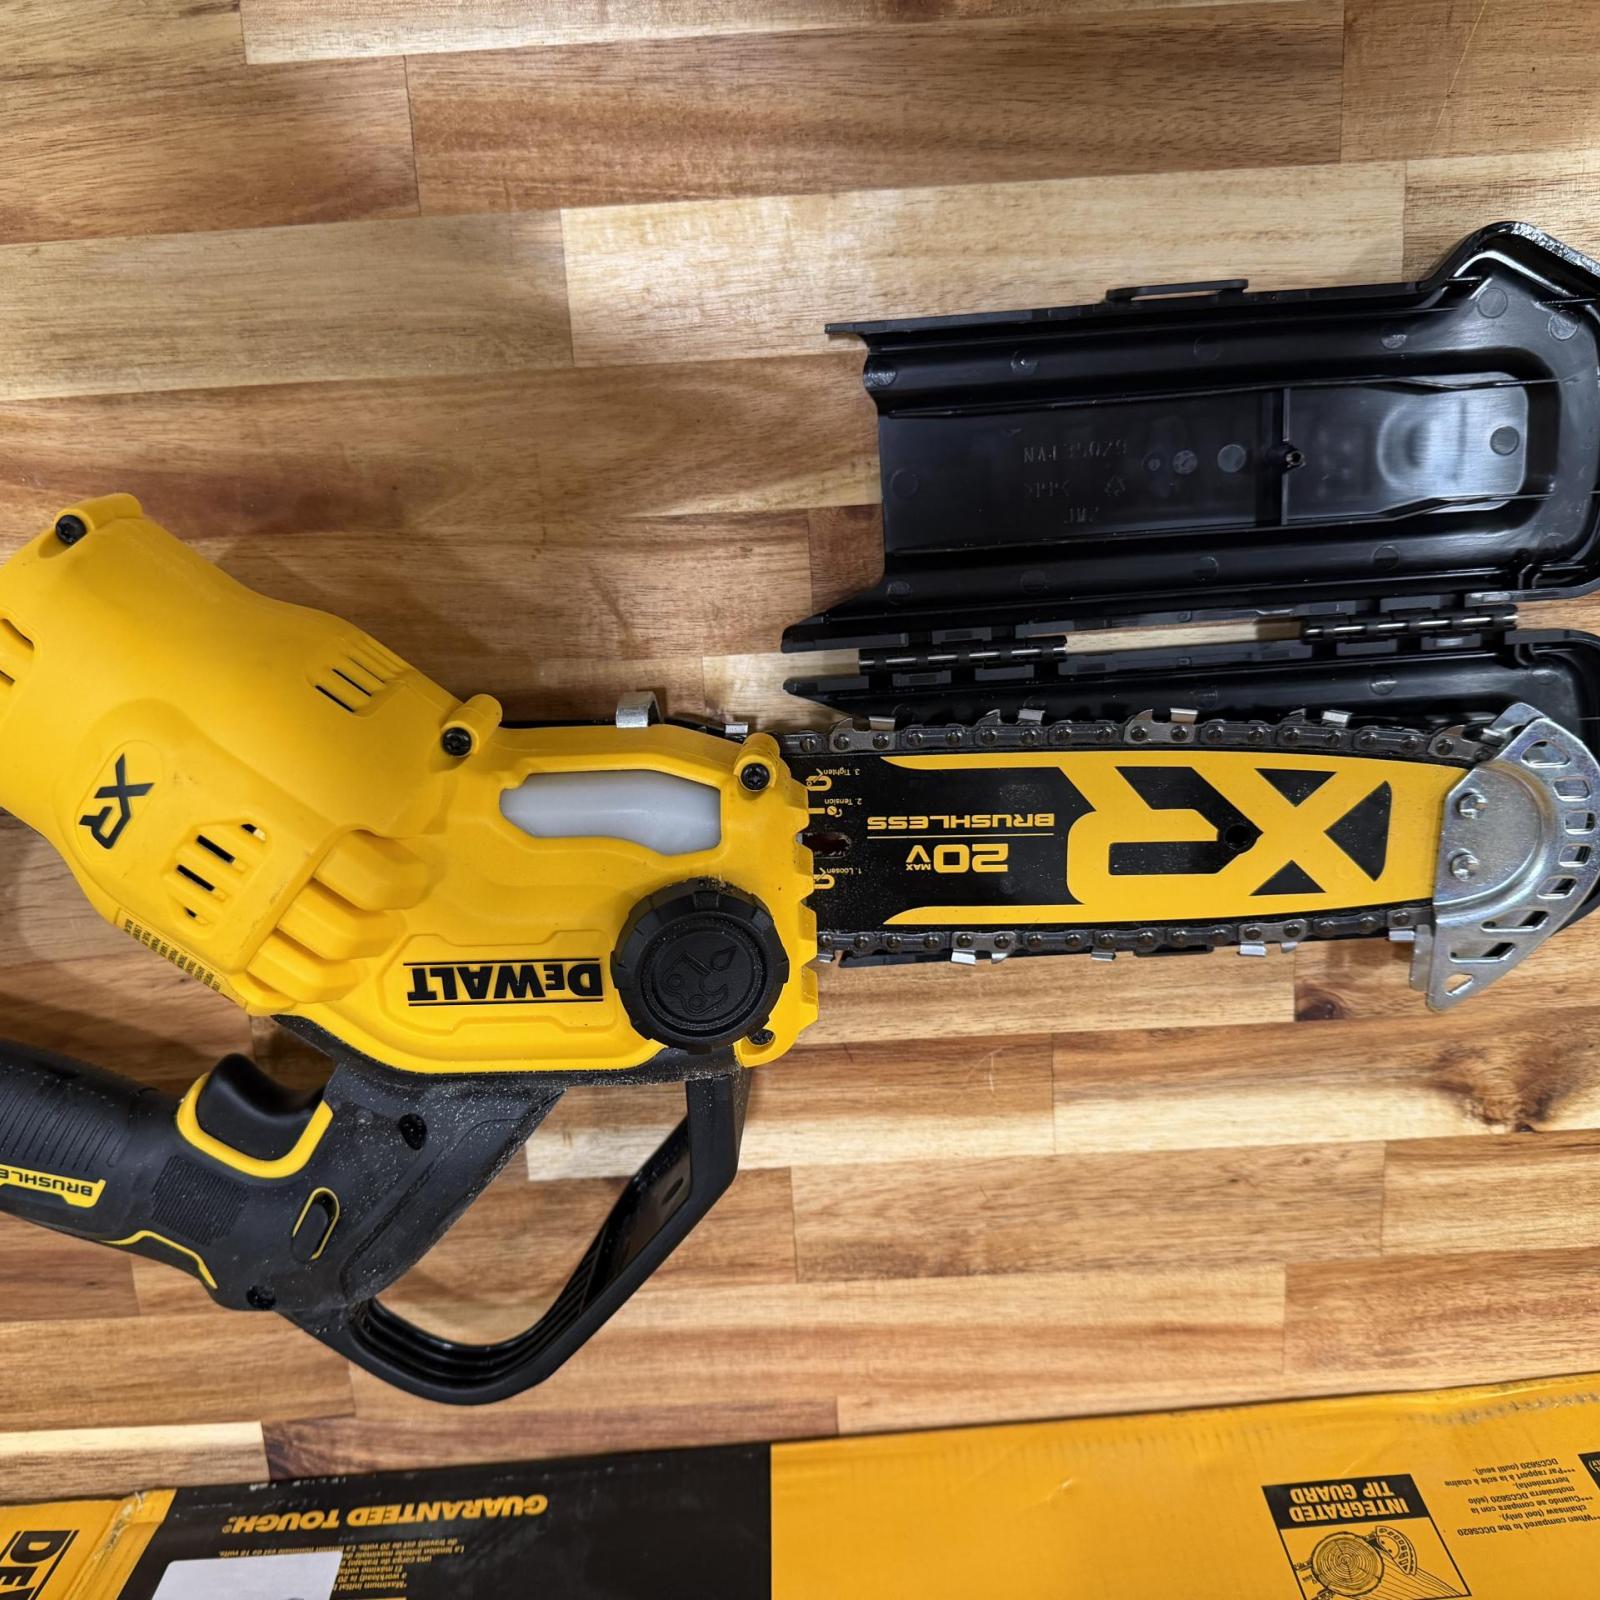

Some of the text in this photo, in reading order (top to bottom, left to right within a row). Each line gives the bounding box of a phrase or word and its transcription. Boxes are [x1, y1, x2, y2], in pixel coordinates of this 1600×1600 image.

[823, 767, 850, 776] Tighten
[79, 752, 154, 849] XR
[824, 798, 853, 806] Tension
[867, 814, 1055, 830] BRUSHLESS
[1058, 766, 1386, 896] XR
[826, 867, 854, 875] Loosen
[407, 964, 603, 1002] DEWALT
[1499, 1475, 1507, 1484] la
[1516, 1468, 1547, 1480] rapport
[1289, 1480, 1394, 1503] TIP GUARD
[1529, 1485, 1575, 1498] motosierra
[1497, 1500, 1534, 1511] compara
[1536, 1499, 1547, 1507] se
[346, 1493, 549, 1527] GUARANTEED
[1288, 1497, 1410, 1522] INTEGRATED
[1470, 1507, 1479, 1515] la
[1480, 1505, 1495, 1513] con
[1525, 1508, 1544, 1519] (tool
[1546, 1504, 1587, 1514] chainsaw
[1497, 1524, 1511, 1533] the
[1513, 1523, 1522, 1531] to
[1524, 1517, 1566, 1529] compared
[1457, 1525, 1496, 1536] DCCS620
